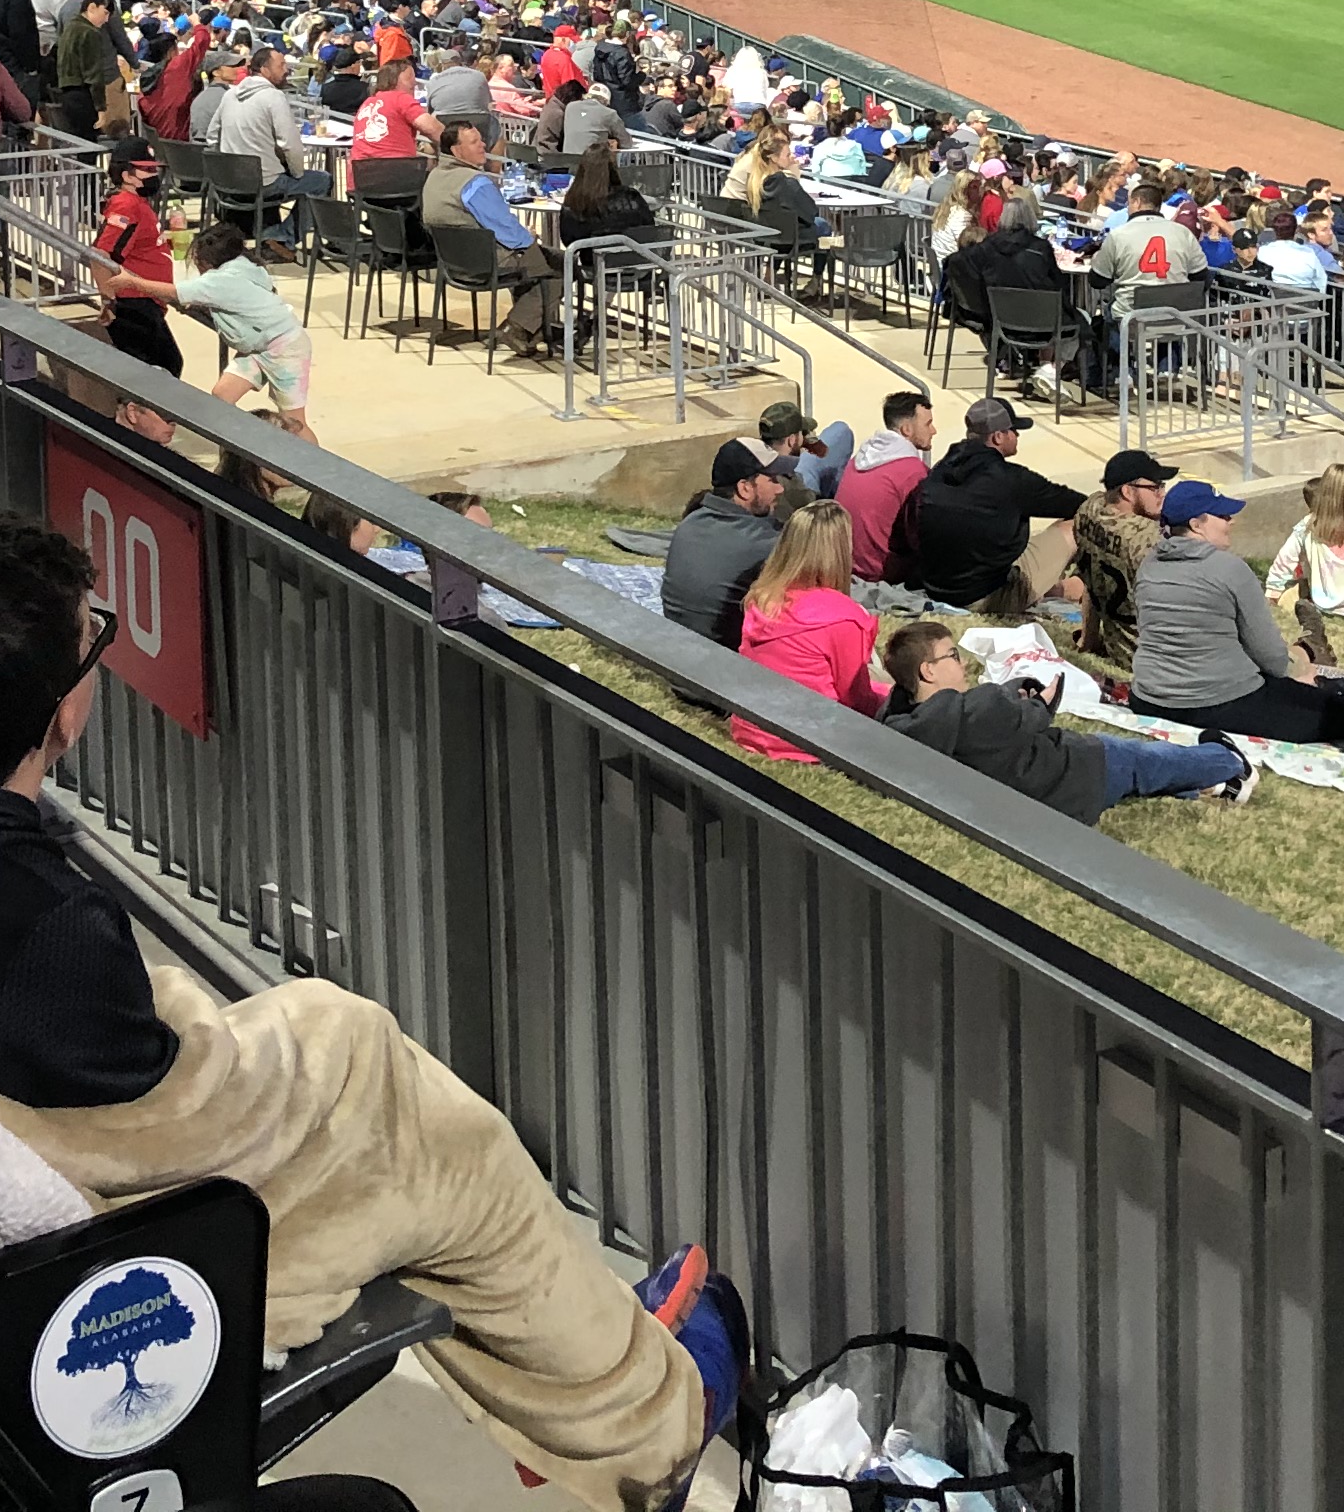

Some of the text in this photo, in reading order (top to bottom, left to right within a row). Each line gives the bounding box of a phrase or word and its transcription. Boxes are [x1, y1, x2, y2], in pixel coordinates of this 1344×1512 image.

[1139, 236, 1171, 279] 4
[82, 487, 162, 658] 00
[79, 1291, 171, 1339] MADISON
[92, 1316, 163, 1348] ALABAMA
